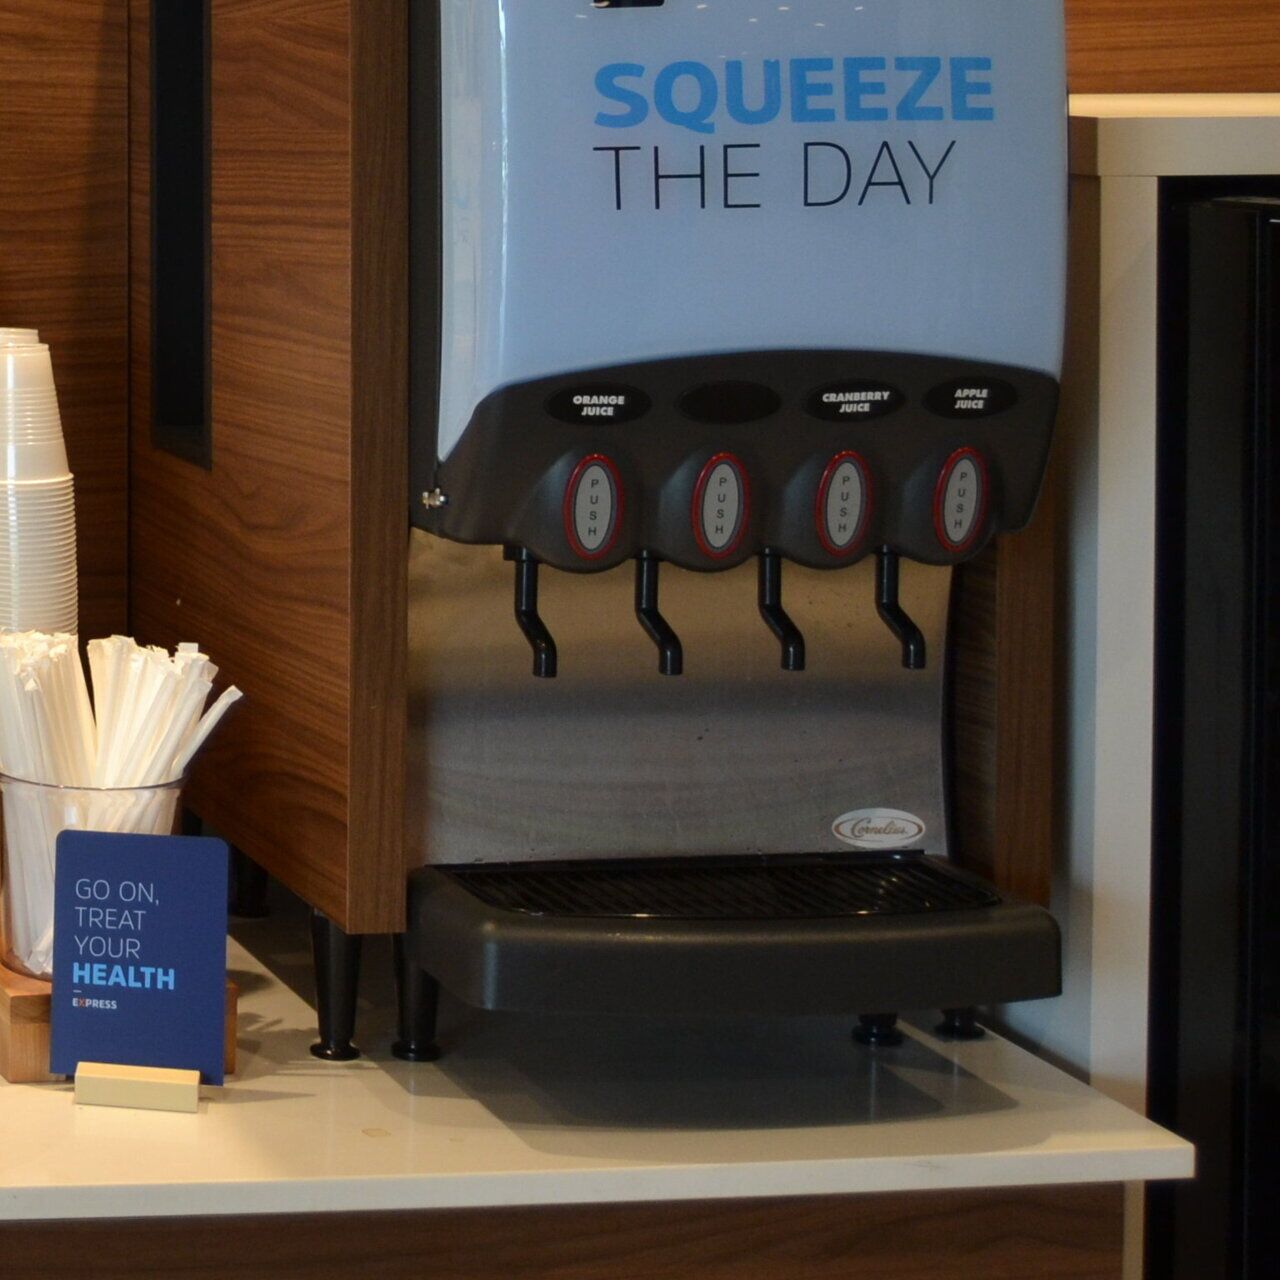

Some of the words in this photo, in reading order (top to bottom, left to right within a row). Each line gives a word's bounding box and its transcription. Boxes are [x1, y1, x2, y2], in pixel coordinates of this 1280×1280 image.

[593, 56, 995, 135] SQUEEZE
[593, 143, 761, 211] THE
[803, 140, 956, 207] DAY
[572, 394, 625, 406] ORANGE
[822, 390, 891, 403] CRANBERRY
[954, 388, 989, 400] APPLE
[954, 399, 984, 410] JUICE
[581, 405, 615, 416] JUICE
[839, 401, 871, 413] JUICE
[587, 478, 600, 538] PUSH
[714, 476, 728, 535] PUSH
[837, 475, 851, 533] PUSH
[952, 471, 968, 529] PUSH
[75, 878, 110, 901] GO
[119, 881, 160, 906] ON,
[75, 906, 147, 931] TREAT
[74, 935, 141, 959] YOUR
[72, 962, 175, 990] HEALTH
[72, 997, 117, 1010] EXPRESS
